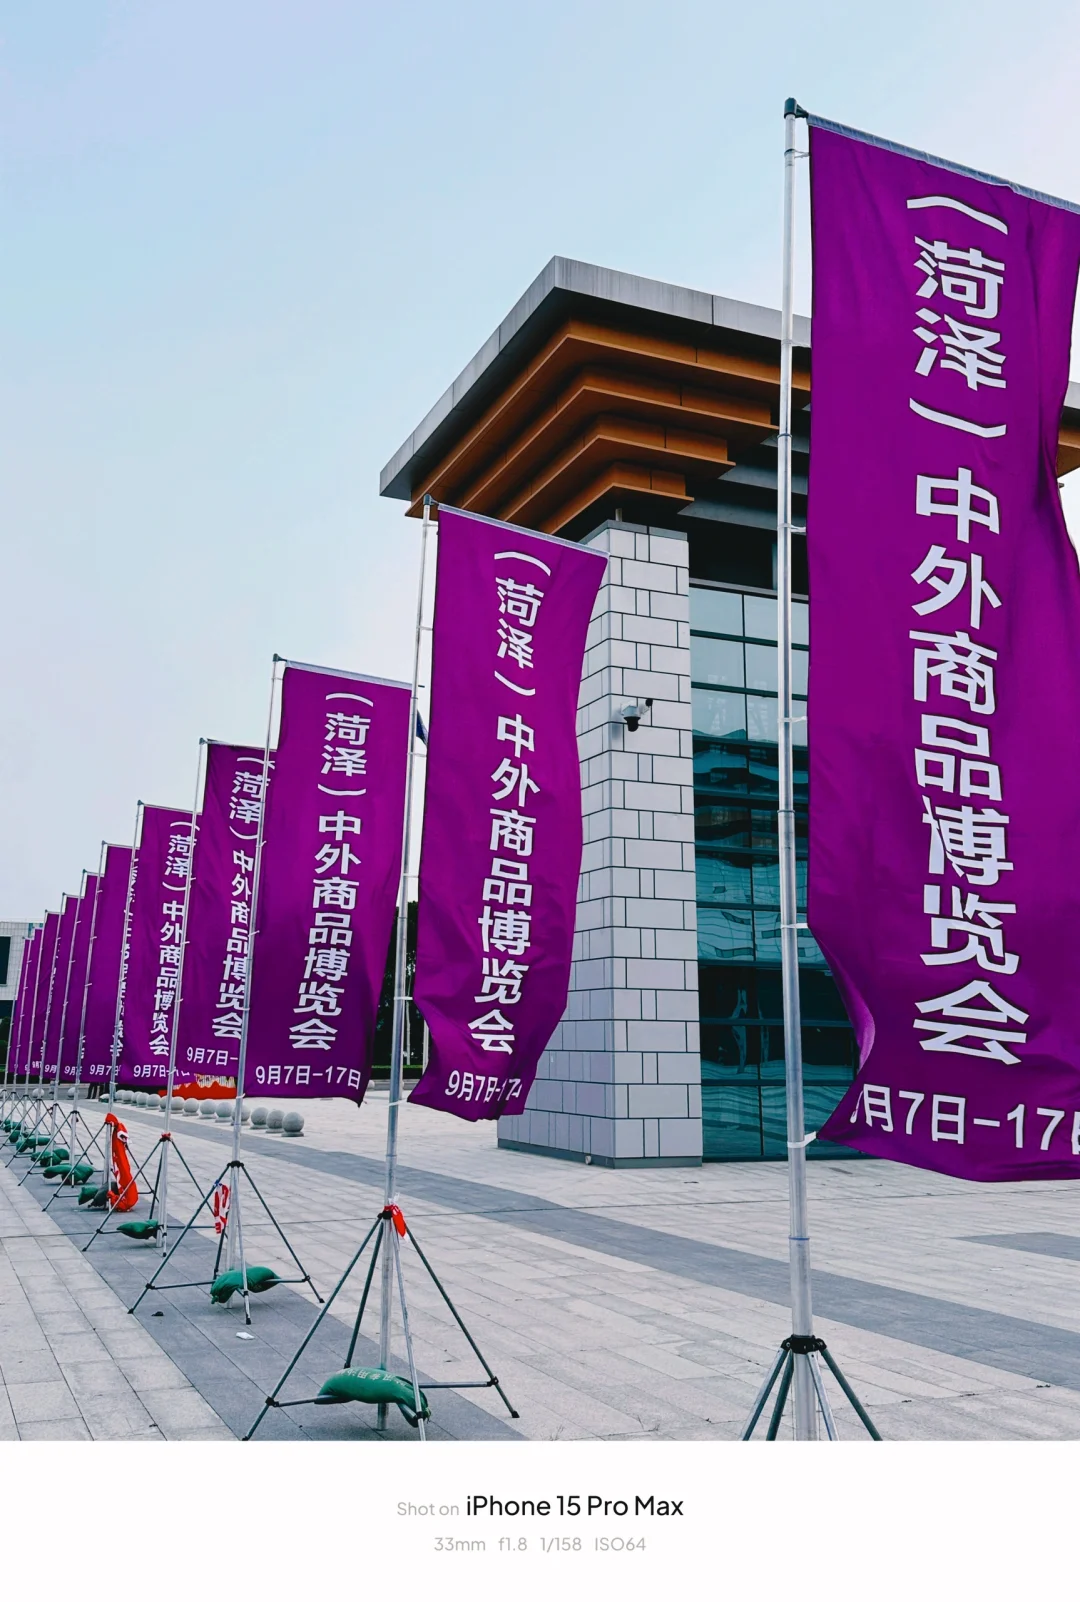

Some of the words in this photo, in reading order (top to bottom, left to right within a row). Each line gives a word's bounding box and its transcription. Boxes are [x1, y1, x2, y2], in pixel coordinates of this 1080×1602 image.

[467, 550, 551, 1056] （菏泽）中外商品博览会
[906, 195, 1029, 1066] （菏泽）中外商品博览会
[288, 692, 374, 1051] （菏泽）中外商品博览会
[255, 1065, 362, 1091] 9月7日-17日
[849, 1083, 1080, 1156] 月7日-17
